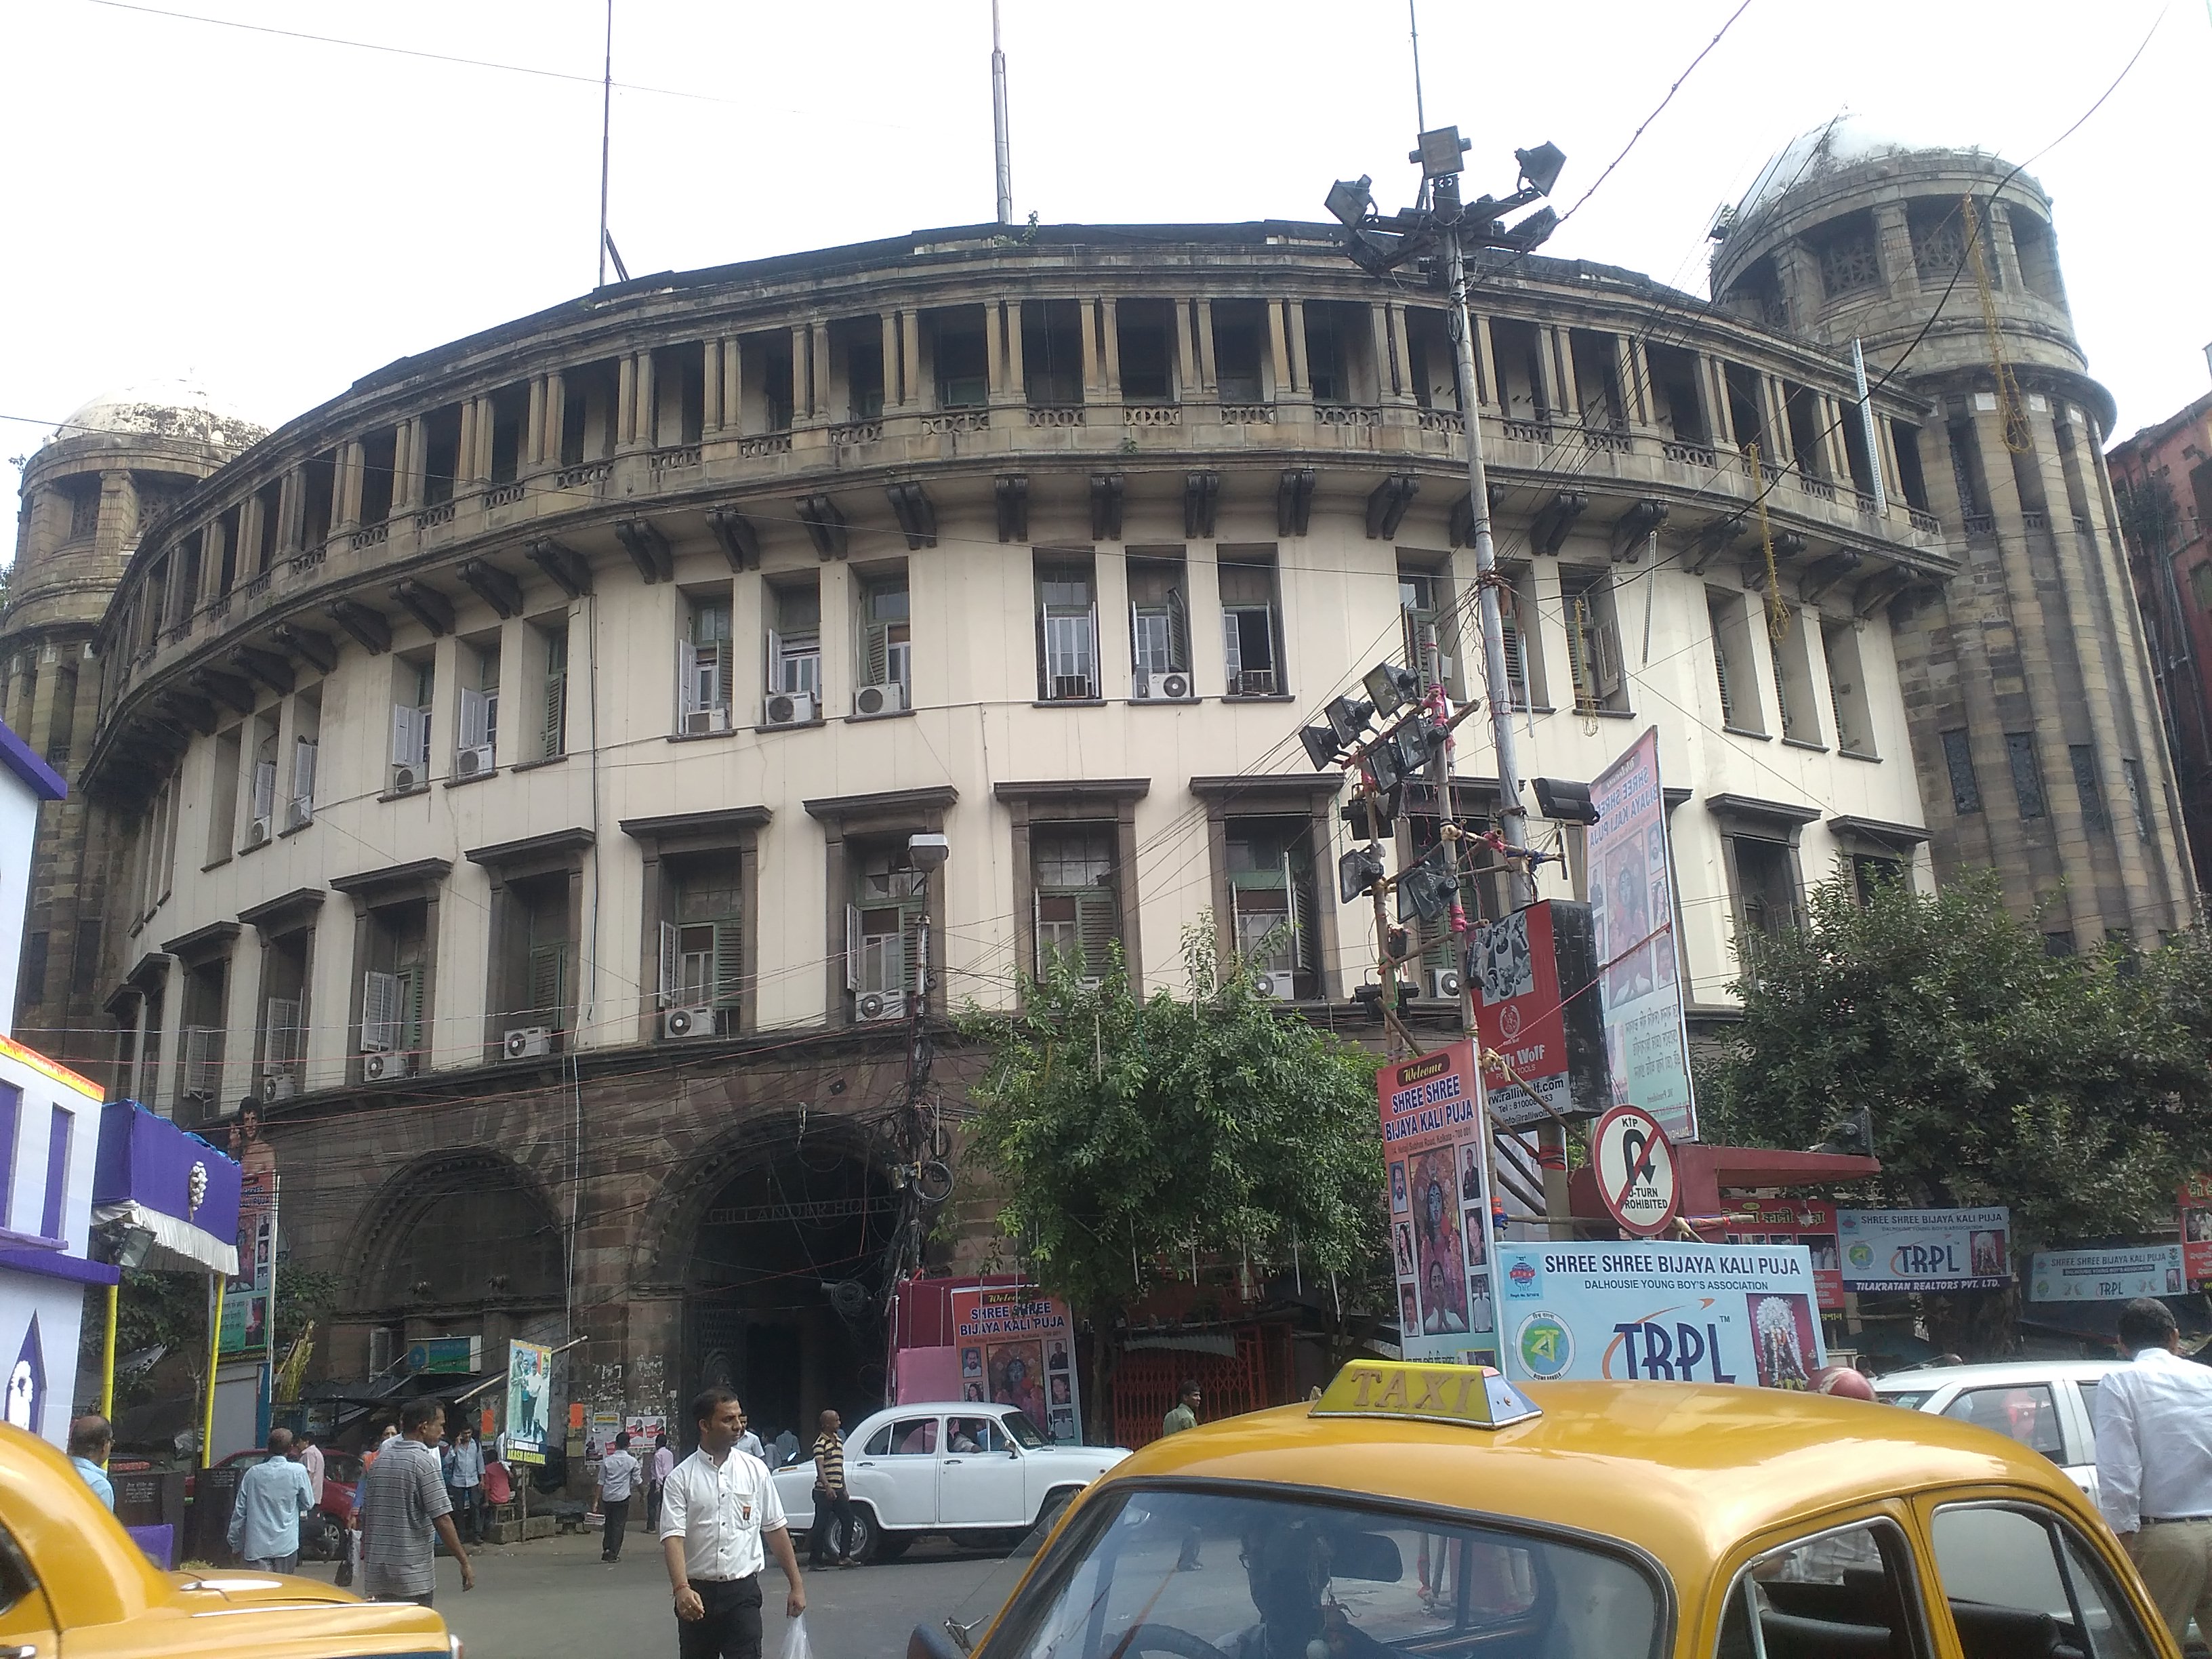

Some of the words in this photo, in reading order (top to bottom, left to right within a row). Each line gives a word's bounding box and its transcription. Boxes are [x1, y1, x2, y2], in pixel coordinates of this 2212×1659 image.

[1517, 1044, 1545, 1065] Wolf
[1404, 1063, 1442, 1082] Welcome
[1517, 1064, 1536, 1074] TOOLS
[1392, 1087, 1424, 1113] SHREE
[1426, 1074, 1460, 1103] SHREE
[1498, 1104, 1509, 1113] Tel
[1385, 1115, 1418, 1141] BIJAYA
[1420, 1107, 1444, 1132] KALI
[1446, 1099, 1474, 1125] PUJA
[1861, 1216, 1890, 1224] SHREE
[1892, 1215, 1919, 1224] SHREE
[1922, 1215, 1953, 1223] BIJAYA
[1957, 1214, 1975, 1223] KALI
[1979, 1214, 2002, 1222] PUJA
[1545, 1255, 1597, 1273] SHREE
[1602, 1255, 1654, 1273] SHREE
[1658, 1256, 1716, 1273] BIJAYA
[1720, 1257, 1754, 1274] KALI
[1759, 1258, 1801, 1275] PUJA
[1897, 1246, 1961, 1273] TRPL
[2102, 1255, 2127, 1265] BIJAYA
[1584, 1280, 1639, 1289] DALHOUSIE
[1642, 1280, 1675, 1289] YOUNG
[1677, 1281, 1705, 1290] BOY'S
[1708, 1282, 1768, 1290] ASSOCIATION
[1856, 1282, 1911, 1291] TILAKRATAN
[1914, 1280, 1958, 1290] REALTORS
[971, 1306, 1009, 1320] SHREE
[960, 1322, 1000, 1336] BIJAYA
[1004, 1318, 1030, 1332] KALI
[1033, 1316, 1064, 1328] PUJA
[1613, 1322, 1736, 1384] TRPL
[1351, 1368, 1475, 1413] TAXI
